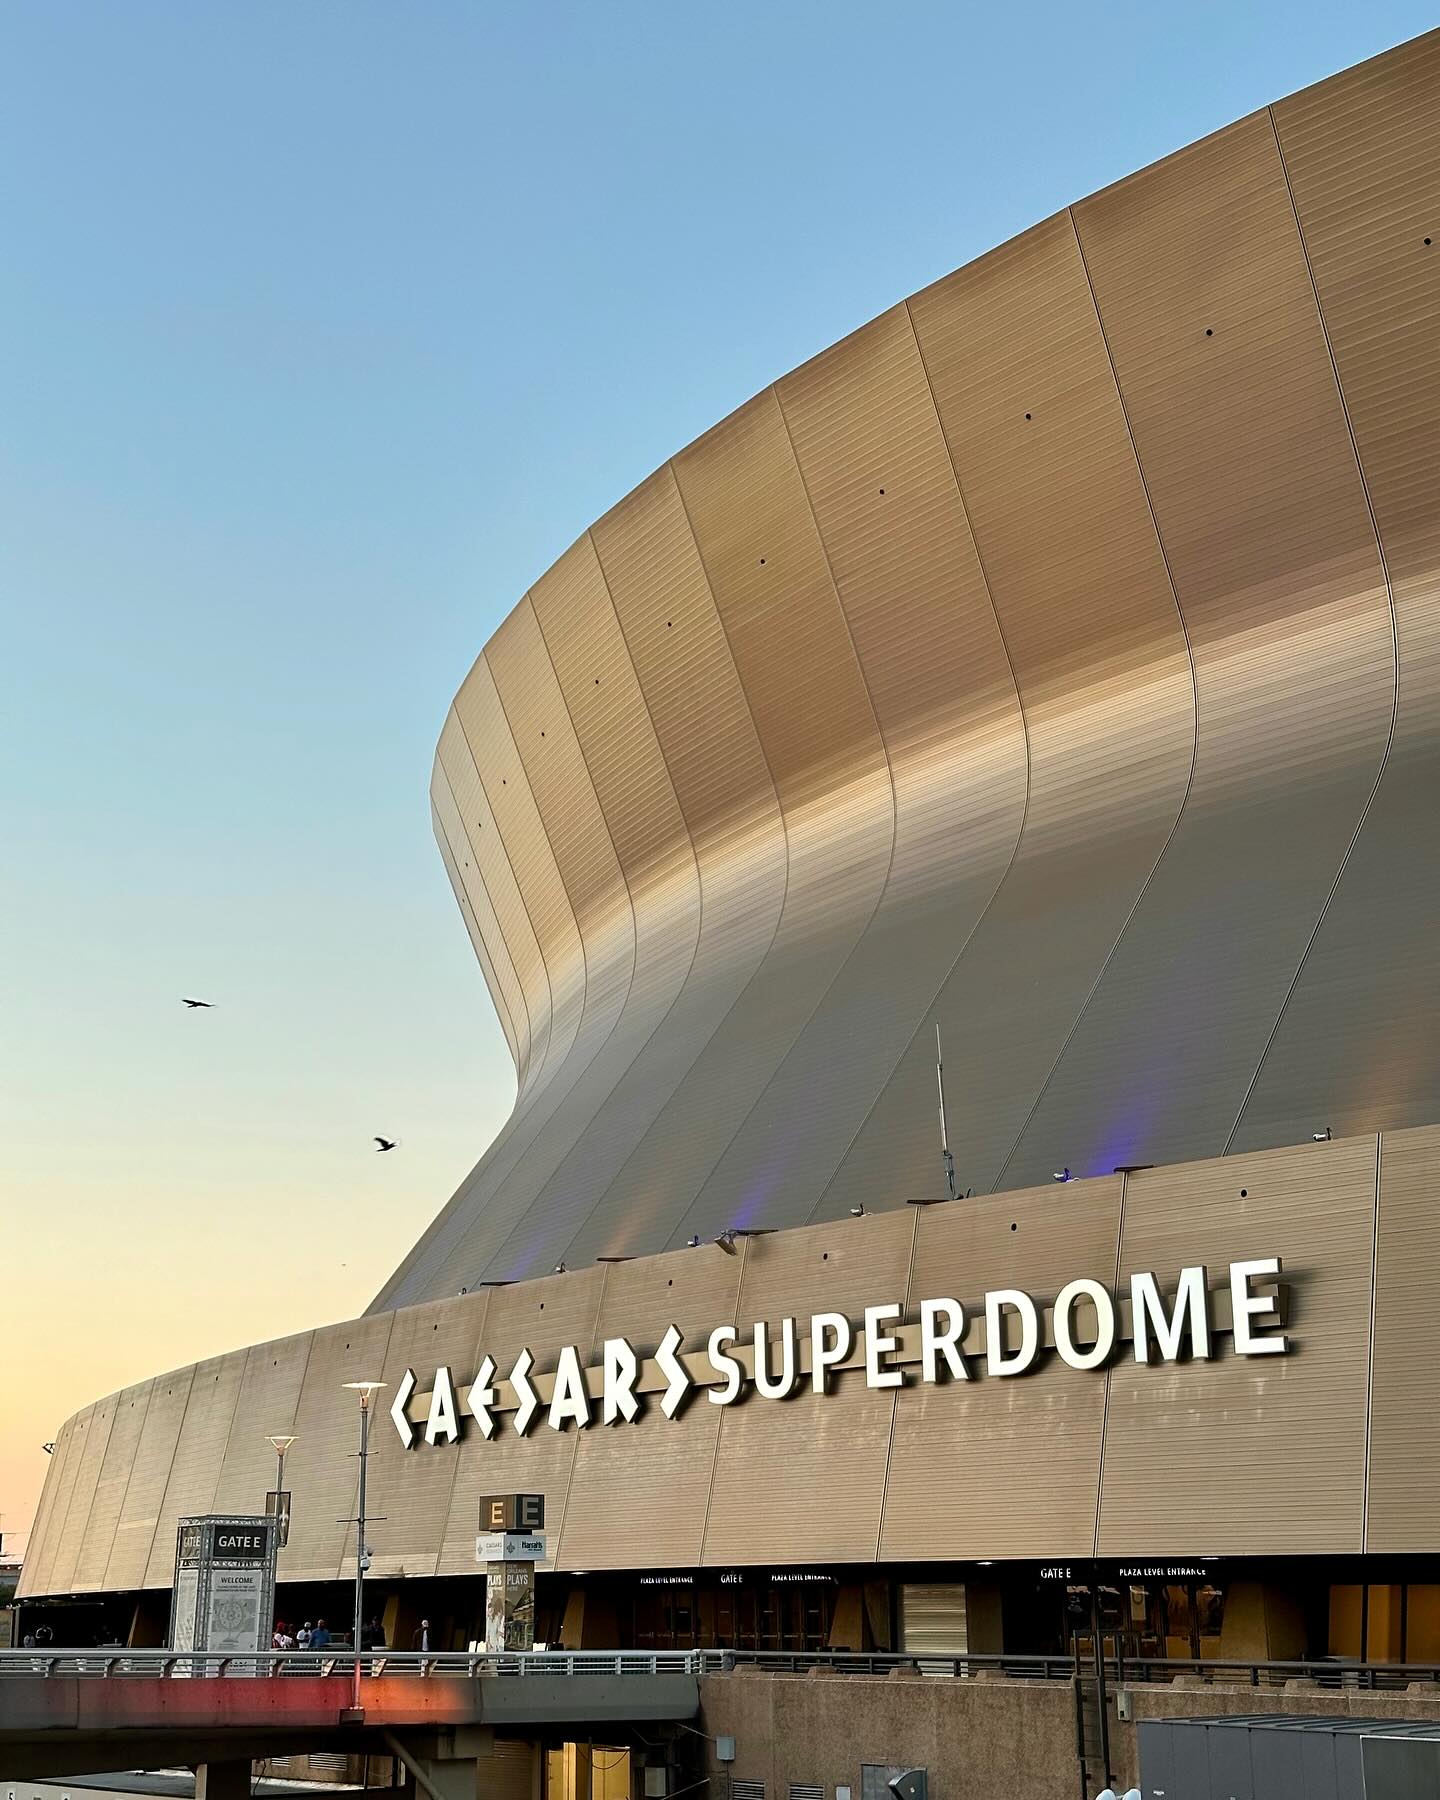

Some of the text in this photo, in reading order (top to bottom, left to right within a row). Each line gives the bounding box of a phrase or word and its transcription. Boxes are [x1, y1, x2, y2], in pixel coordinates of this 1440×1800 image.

[390, 1257, 1289, 1450] CAESARS SUPERDOME
[492, 1502, 503, 1524] E
[522, 1497, 539, 1525] E
[218, 1535, 261, 1548] GATE E
[1040, 1568, 1071, 1579] GATE E
[1119, 1568, 1142, 1576] PLAZA
[1143, 1568, 1165, 1576] LEVEL
[506, 1574, 529, 1585] PLAYS
[720, 1574, 743, 1583] GATE E
